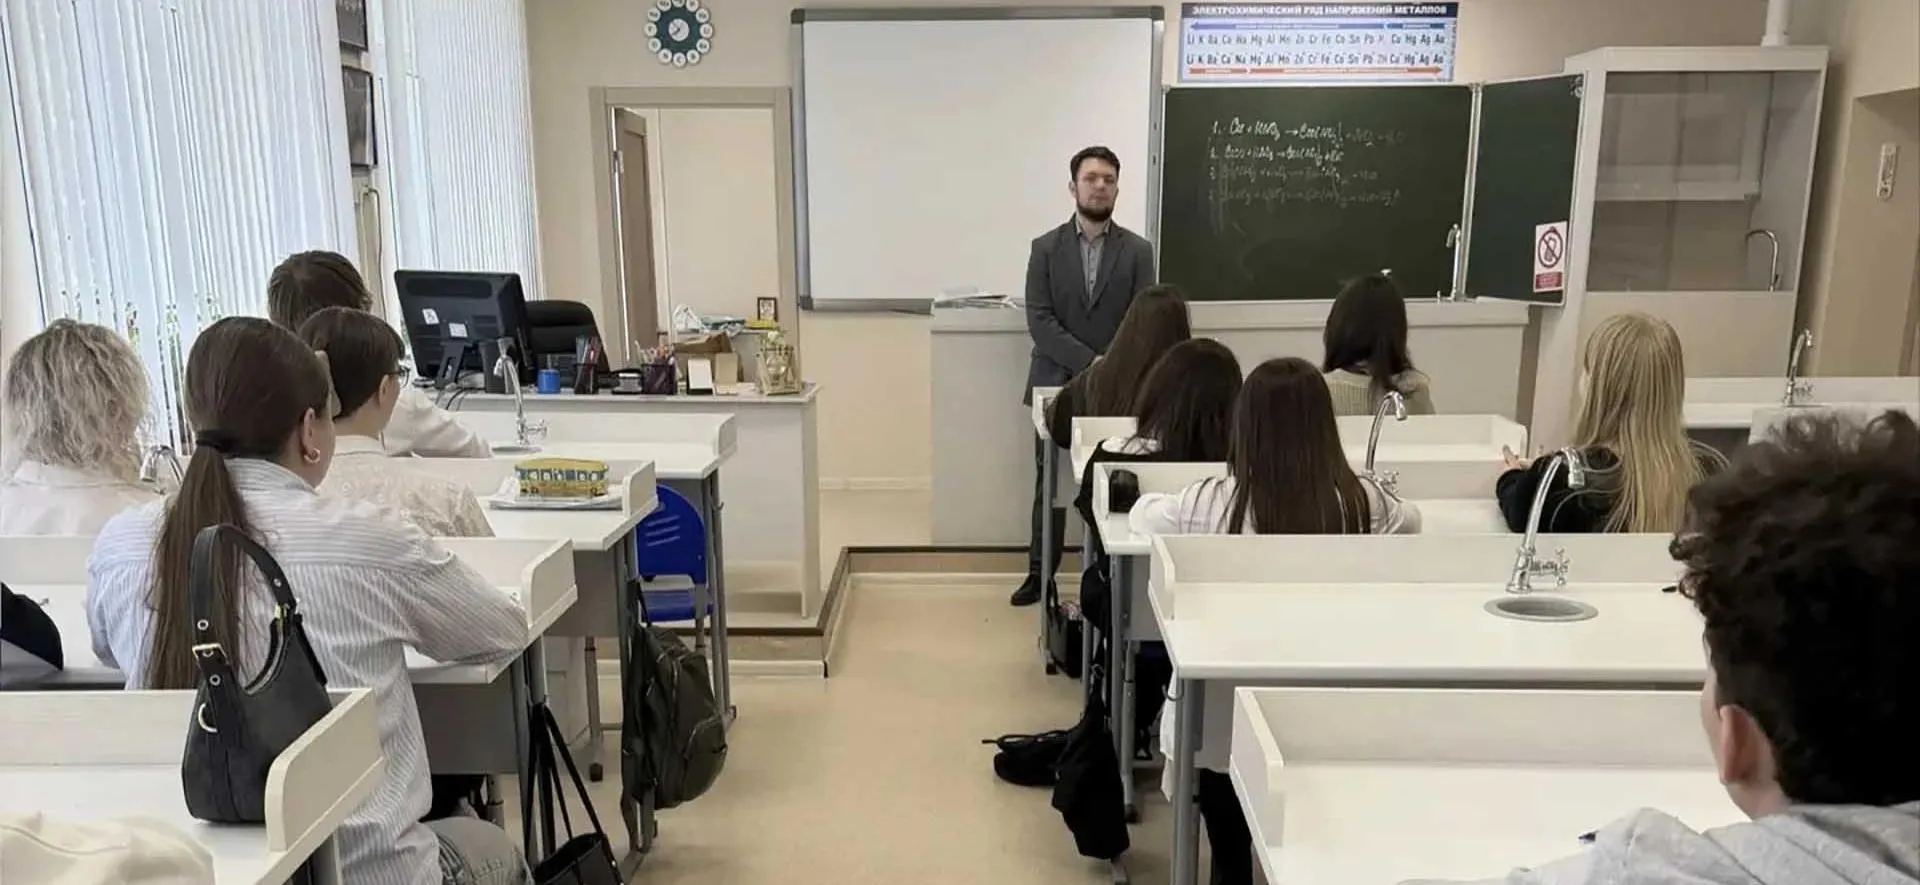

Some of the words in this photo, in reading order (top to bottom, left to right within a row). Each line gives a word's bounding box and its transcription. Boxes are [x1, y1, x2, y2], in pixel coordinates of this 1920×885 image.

[1192, 5, 1301, 15] ЭЛЕКТРОХИМИЧЕСКИЙ
[1303, 6, 1323, 15] РЯД
[1395, 5, 1447, 14] МЕТАЛЛОВ
